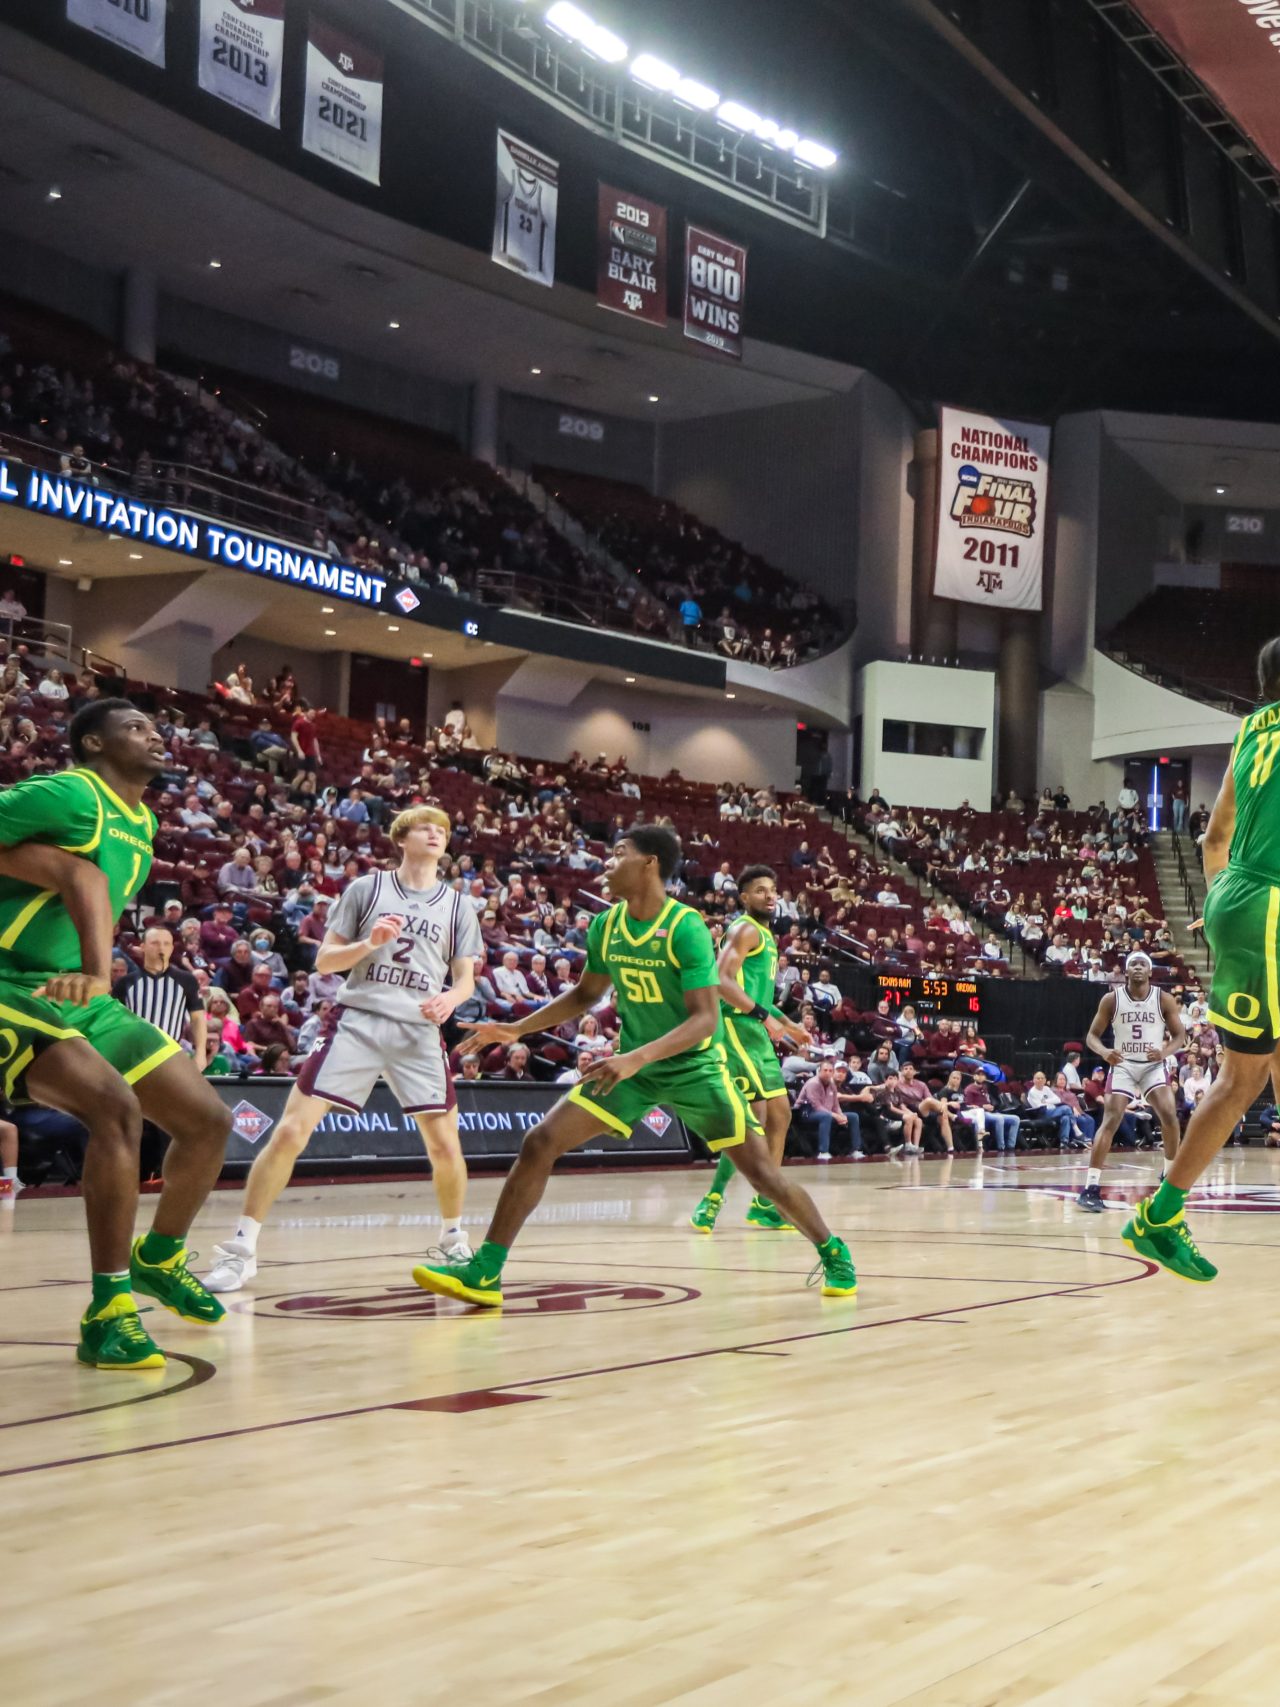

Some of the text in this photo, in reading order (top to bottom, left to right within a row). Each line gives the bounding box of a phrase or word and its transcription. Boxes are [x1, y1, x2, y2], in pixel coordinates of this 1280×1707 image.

[215, 24, 270, 58] CHAMPIONSHIP
[213, 36, 269, 87] 2013
[318, 95, 367, 142] 2021
[616, 202, 649, 228] 2013
[611, 247, 654, 275] GARY
[608, 262, 657, 293] BLAIR
[691, 254, 741, 303] 800
[690, 296, 739, 335] WINS
[289, 350, 339, 381] 208
[559, 414, 604, 442] 209
[961, 427, 1029, 454] NATIONAL
[951, 443, 1038, 472] CHAMPIONS
[977, 474, 1033, 503] FINAL
[1228, 515, 1264, 533] 210
[31, 475, 199, 549] INVITATION
[207, 528, 387, 604] TOURNAMENT
[963, 537, 1019, 568] 2011
[124, 853, 142, 896] 1
[392, 937, 414, 964] 2
[609, 954, 666, 967] OREGON
[365, 963, 429, 992] AGGIES
[620, 967, 664, 1003] 50
[923, 981, 947, 996] 5:53
[969, 997, 979, 1012] 16
[1121, 1012, 1155, 1023] TEXAS
[1132, 1025, 1142, 1039] 5
